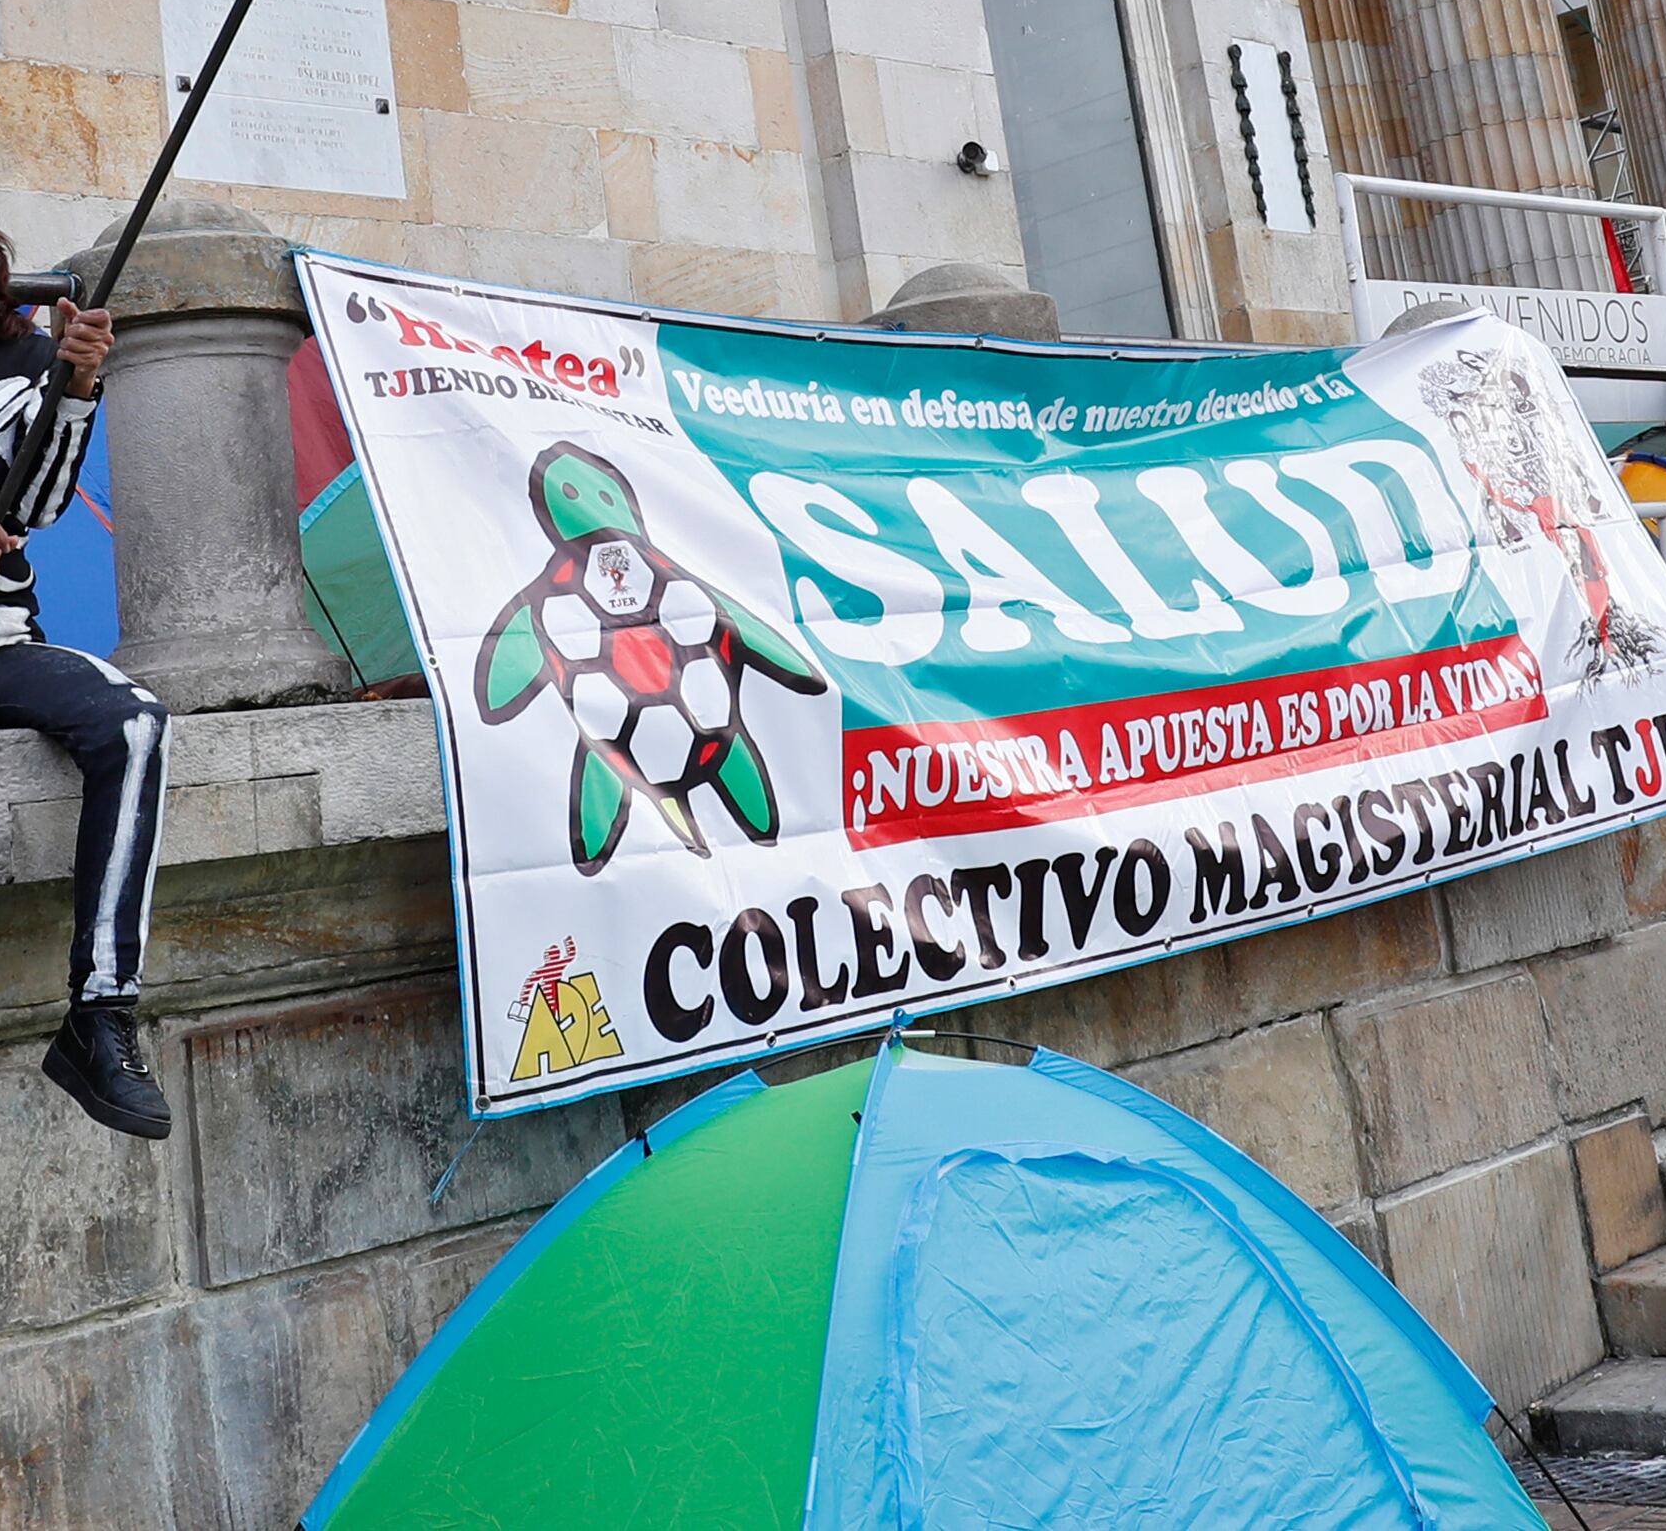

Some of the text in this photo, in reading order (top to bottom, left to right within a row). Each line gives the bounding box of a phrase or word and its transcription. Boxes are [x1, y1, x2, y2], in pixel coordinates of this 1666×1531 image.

[1402, 290, 1649, 344] VENIDOS
[364, 366, 519, 399] TJIENDO
[672, 368, 1354, 435] Veeduría en defensa de nuestro derecho a la
[748, 438, 1479, 667] SALUD
[608, 597, 638, 608] TJER
[851, 650, 1542, 834] ¡NUESTRA APUESTA ES POR LA VIDA!
[644, 836, 1173, 1044] COLECTIVO
[1187, 737, 1595, 924] MAGISTERIAL
[509, 971, 626, 1083] ADE
